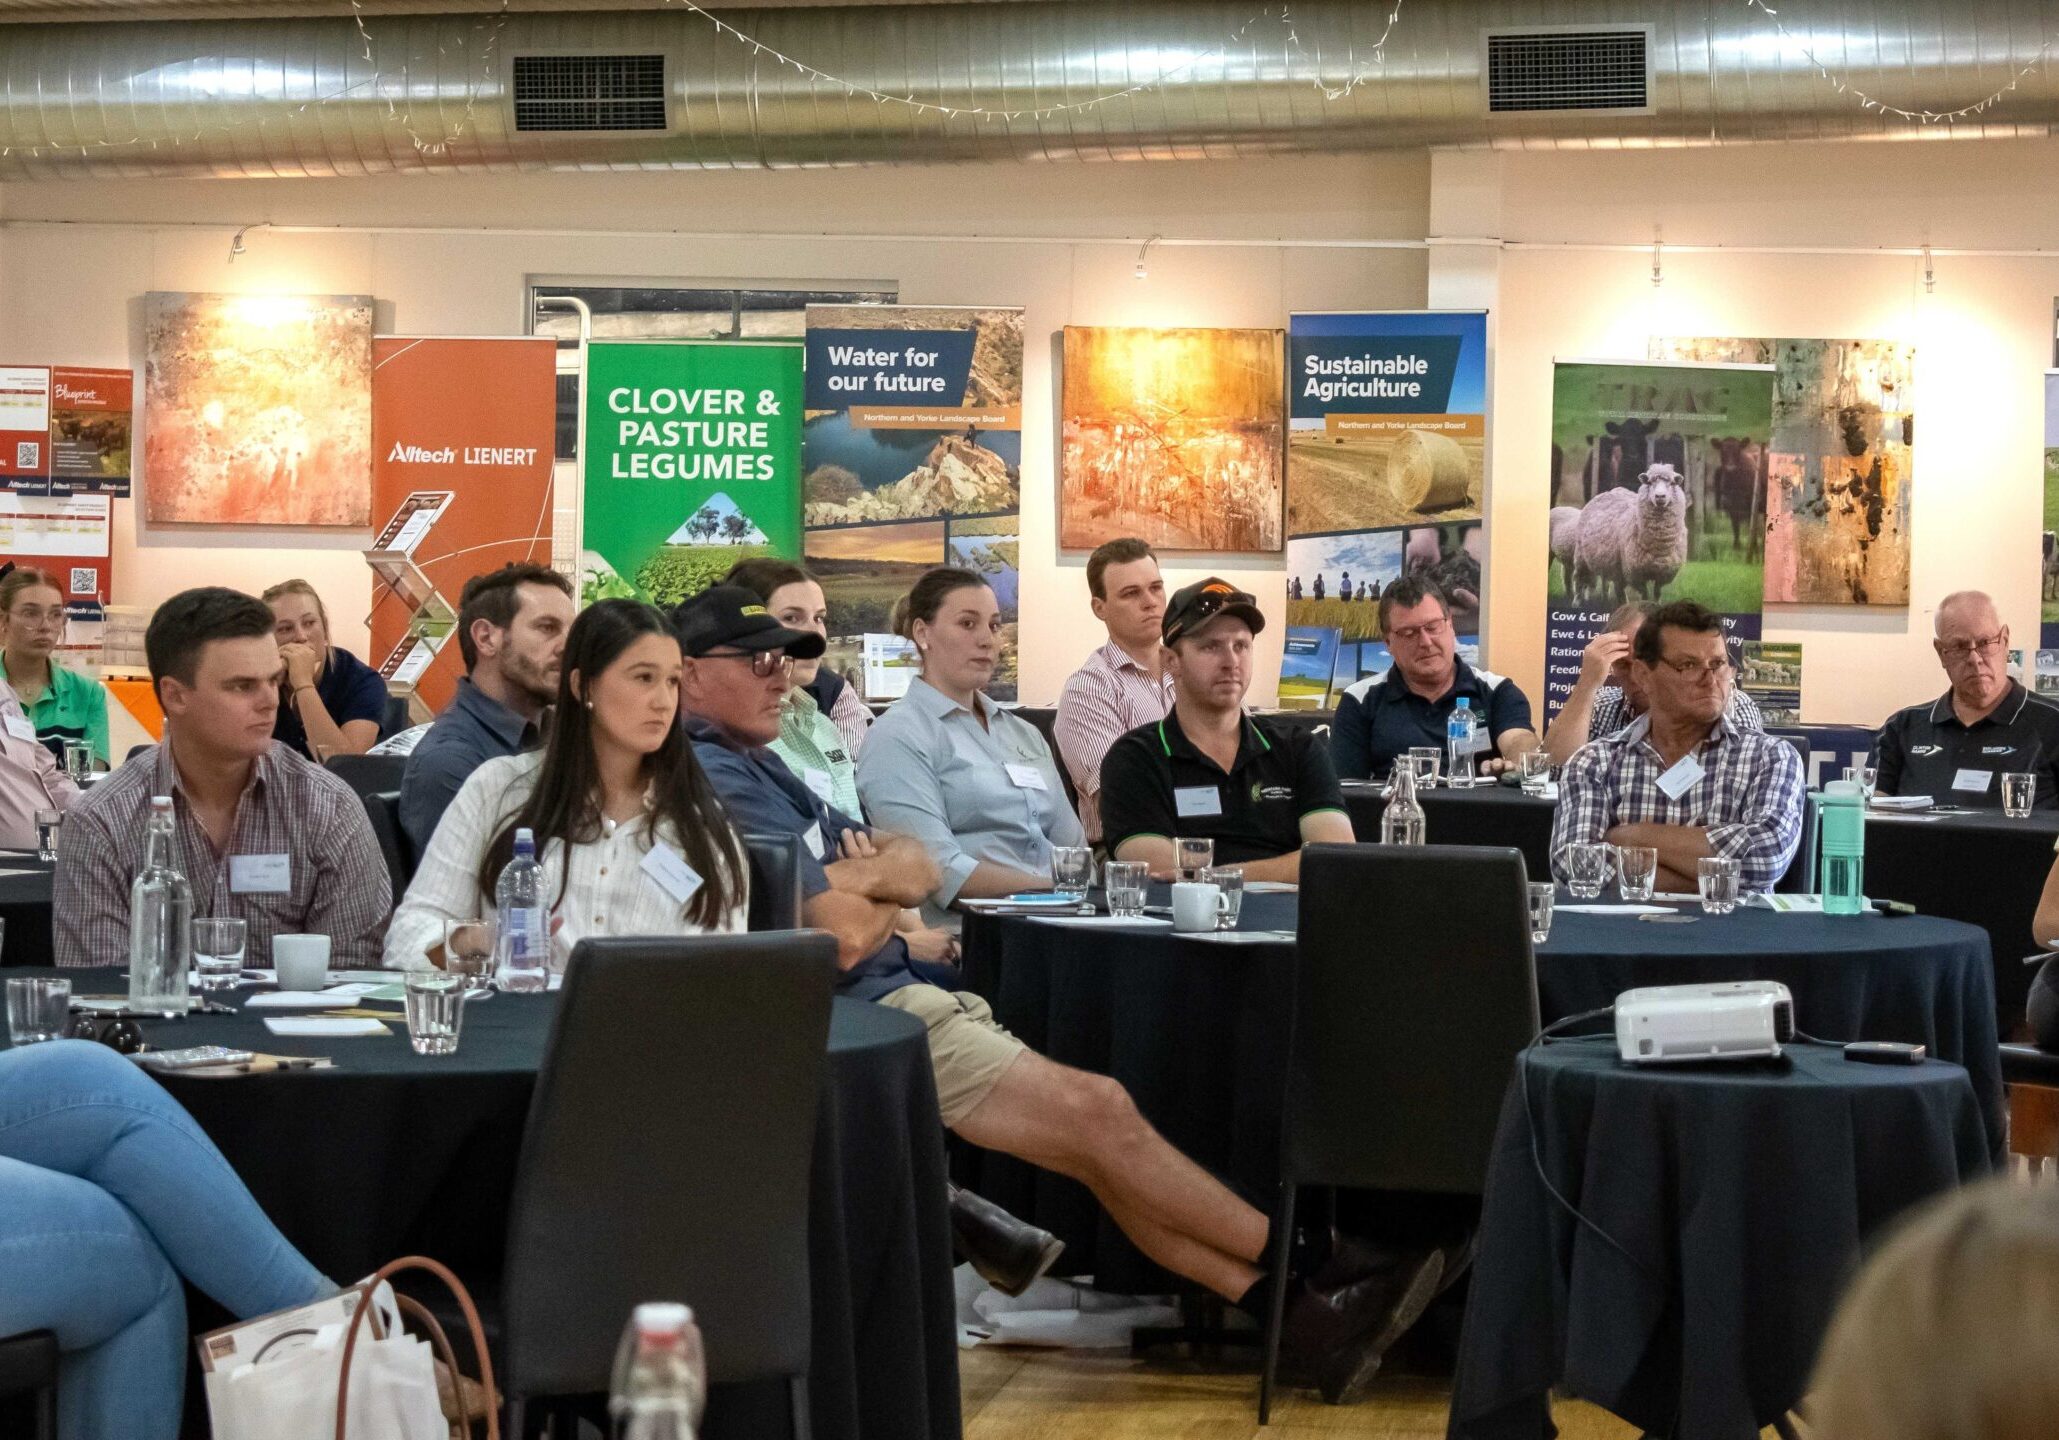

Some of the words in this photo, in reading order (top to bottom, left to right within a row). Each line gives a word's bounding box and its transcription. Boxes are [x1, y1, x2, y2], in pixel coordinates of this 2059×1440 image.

[828, 346, 899, 367] Water
[904, 347, 938, 367] for
[1305, 354, 1429, 375] Sustainable
[828, 375, 868, 391] our
[874, 372, 946, 392] future
[1303, 376, 1422, 402] Agriculture
[55, 384, 97, 405] Blueprint
[608, 387, 745, 415] CLOVER
[756, 389, 781, 416] &
[864, 414, 898, 422] Northern
[900, 414, 914, 422] and
[916, 414, 938, 423] Yorke
[939, 415, 981, 424] Landscape
[1338, 421, 1371, 429] Northern
[1372, 421, 1385, 429] and
[1386, 421, 1405, 429] Yorke
[1406, 422, 1443, 431] Landscape
[619, 420, 769, 447] PASTURE
[388, 441, 455, 463] Alltech
[464, 447, 537, 465] LIENERT
[612, 452, 775, 480] LEGUMES
[1552, 612, 1576, 621] Cow
[1579, 613, 1587, 622] &
[1589, 613, 1610, 622] Calf
[1551, 629, 1575, 639] Ewe
[1577, 631, 1585, 639] &
